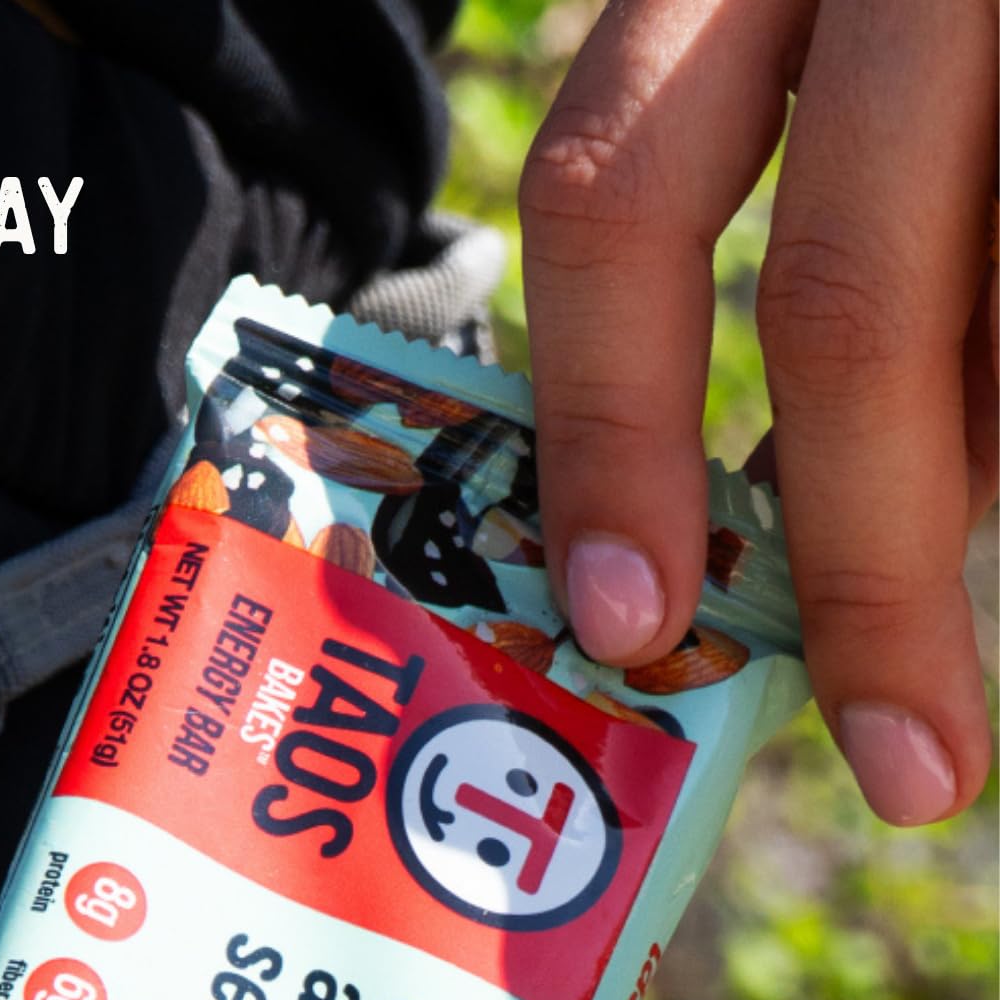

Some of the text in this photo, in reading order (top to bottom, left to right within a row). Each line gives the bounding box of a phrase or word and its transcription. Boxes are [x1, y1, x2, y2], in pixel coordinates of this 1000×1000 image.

[89, 541, 210, 767] NET WT 1.8 OZ (51g)
[168, 593, 274, 776] ENERGY BAR
[252, 638, 426, 859] TAOS
[31, 851, 69, 913] protein
[74, 876, 137, 929] 8g
